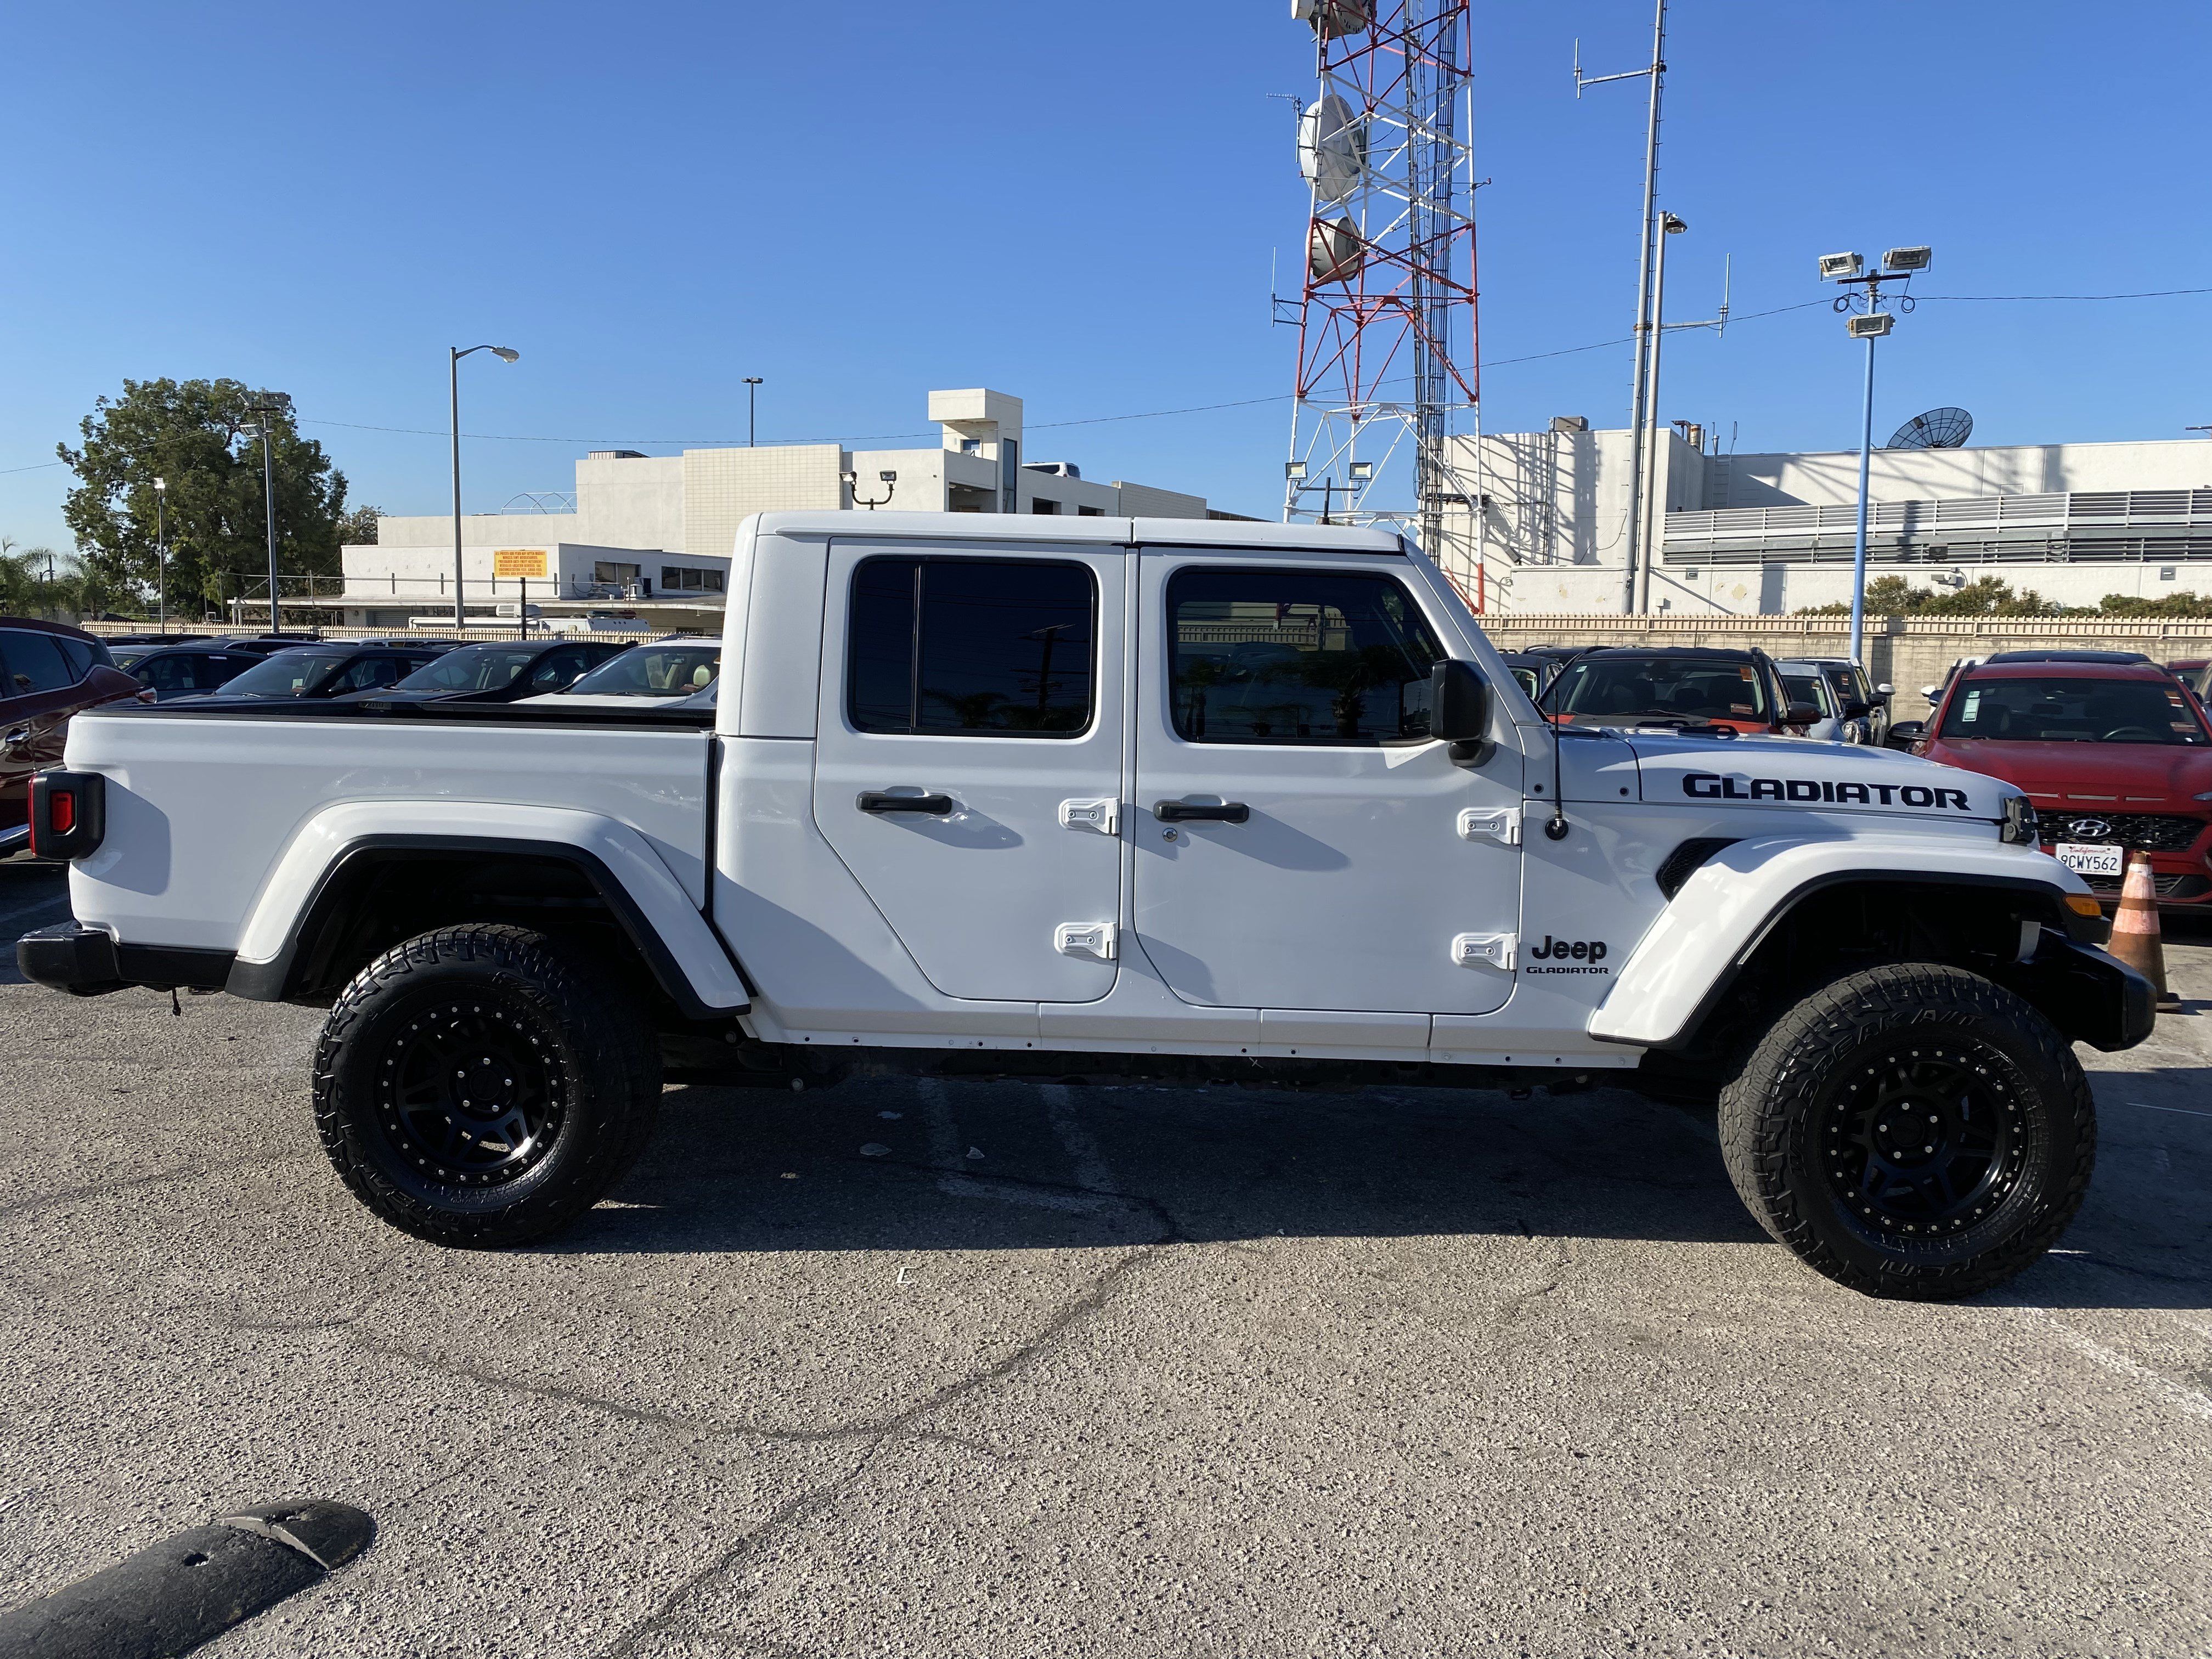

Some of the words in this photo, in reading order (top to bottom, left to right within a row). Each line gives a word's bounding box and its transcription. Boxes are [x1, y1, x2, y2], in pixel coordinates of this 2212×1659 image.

[1683, 774, 1972, 811] GLADIATOR
[2069, 847, 2107, 855] California
[2061, 855, 2118, 871] 9CWY562
[1532, 935, 1607, 964] Jeep
[1526, 966, 1609, 974] GLADIATOR
